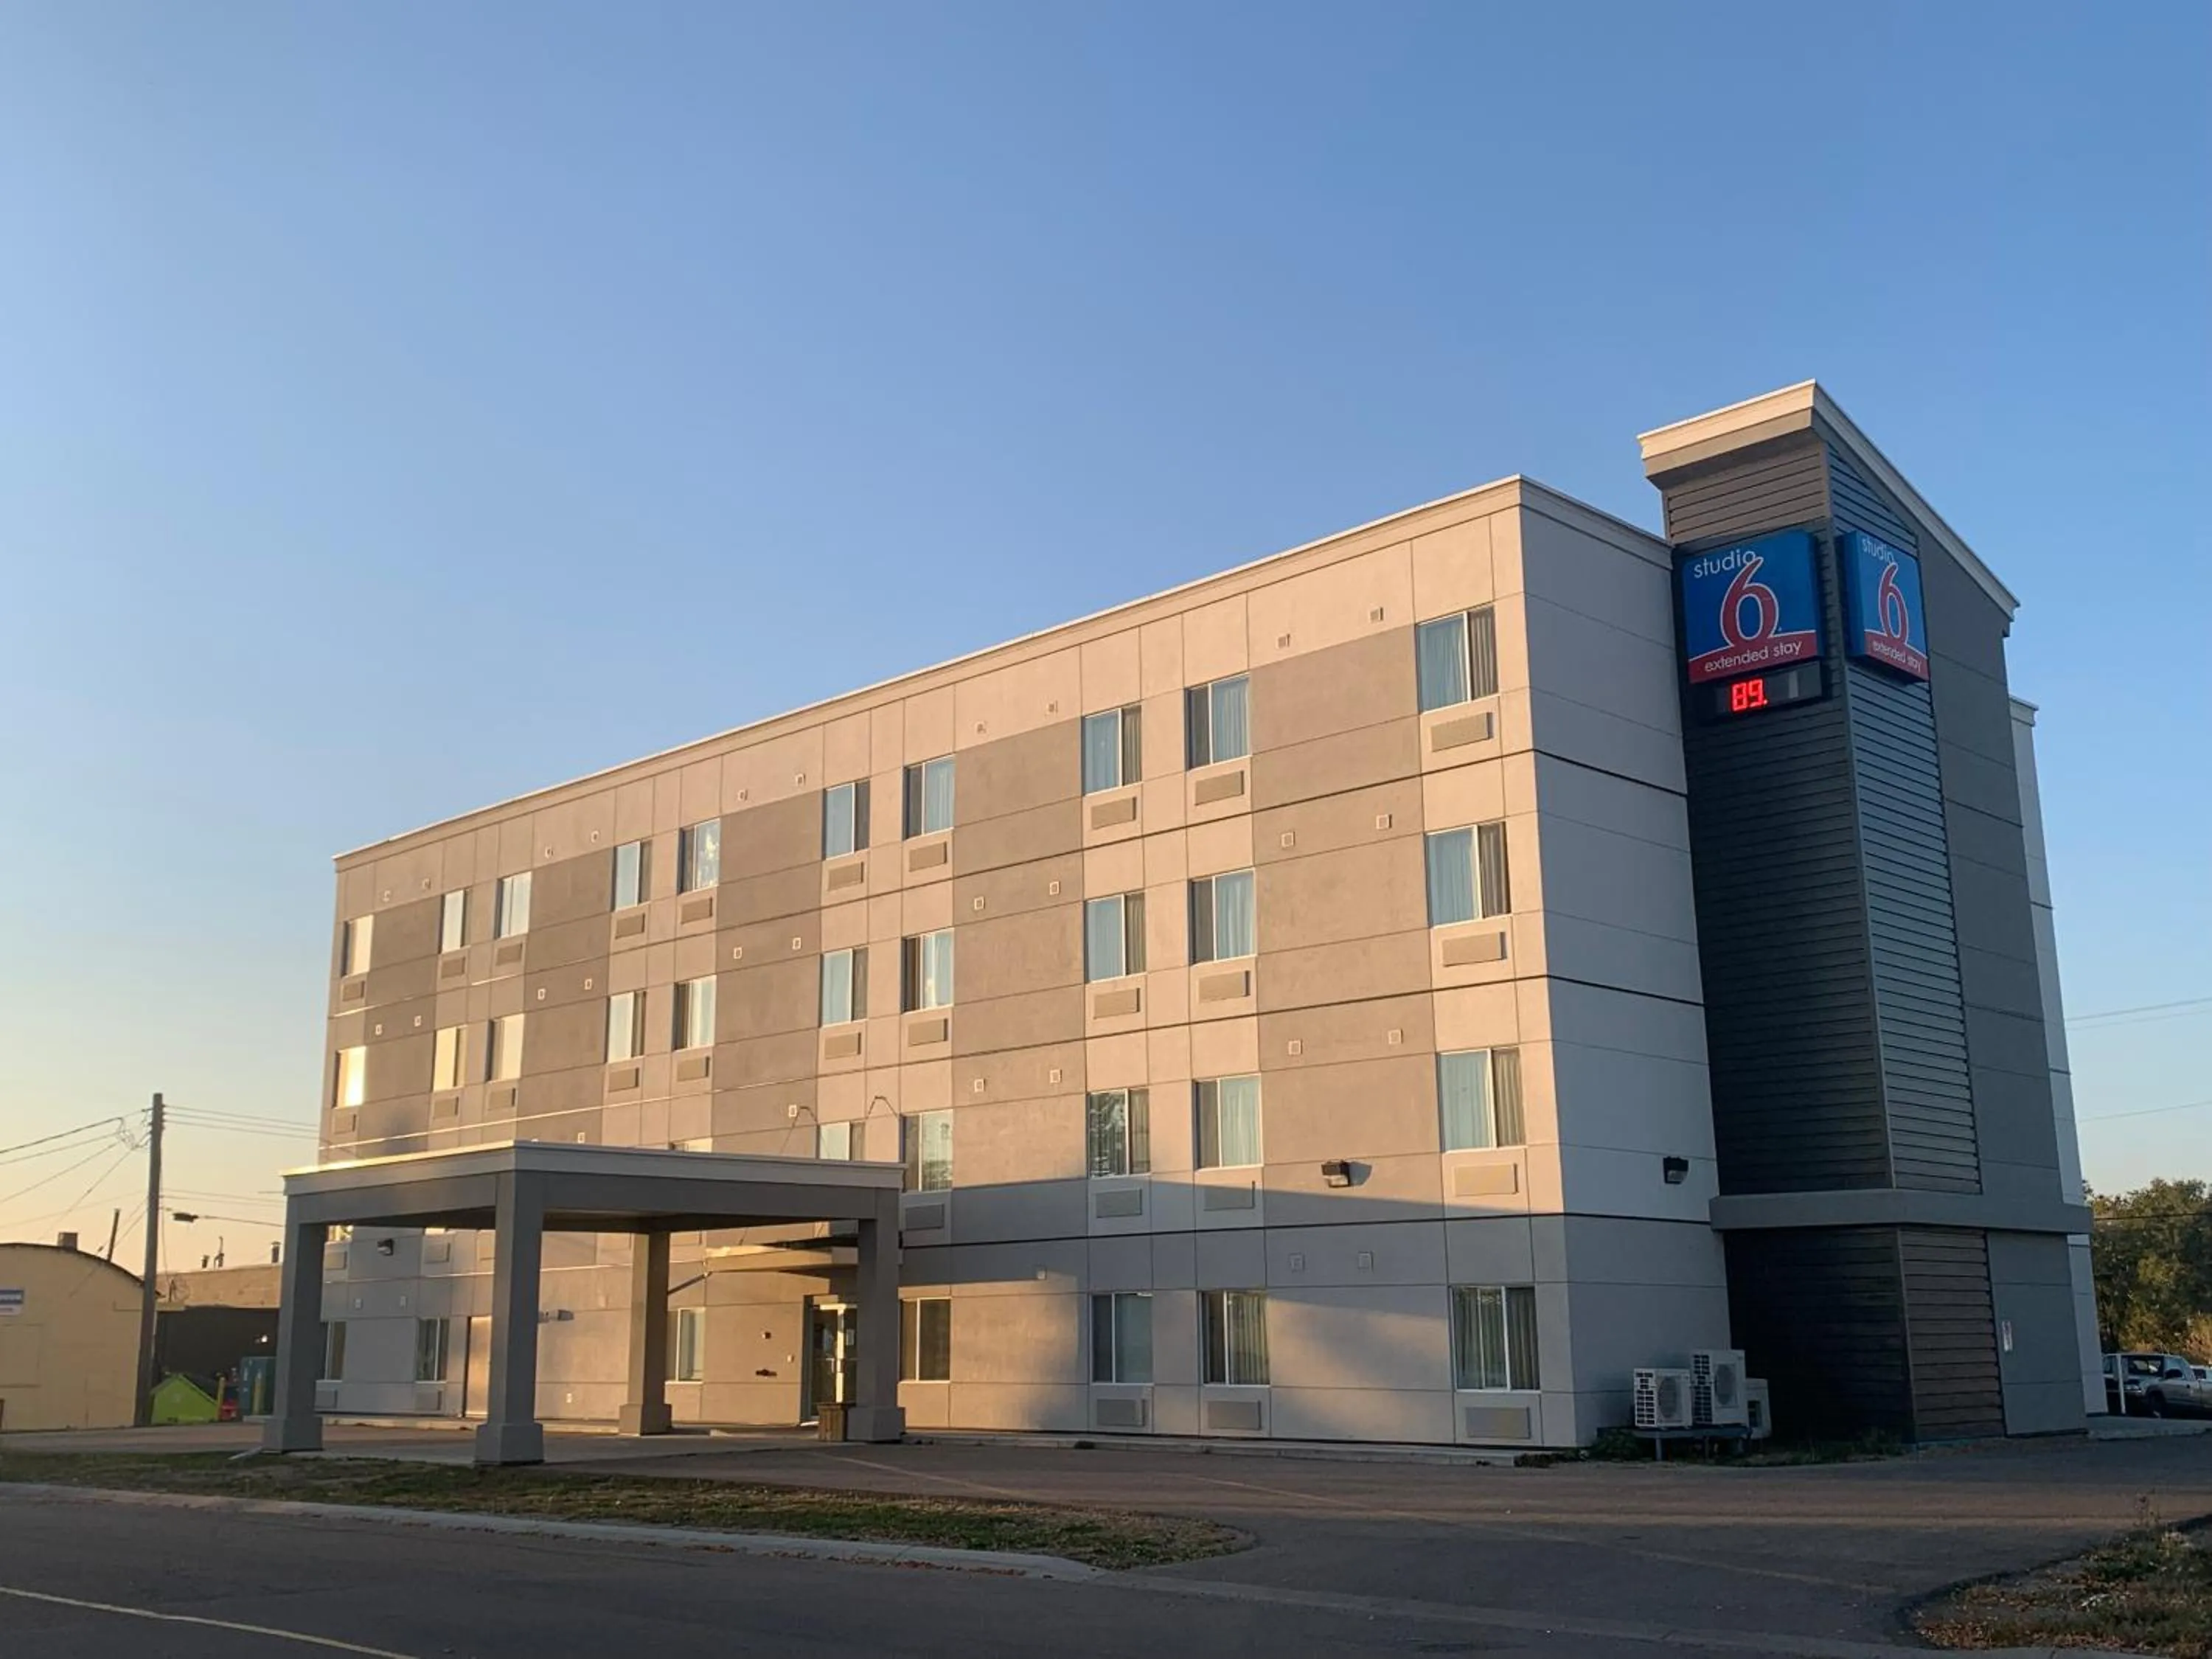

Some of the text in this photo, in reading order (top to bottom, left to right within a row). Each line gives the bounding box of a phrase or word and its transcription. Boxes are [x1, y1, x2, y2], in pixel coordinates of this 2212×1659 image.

[1694, 548, 1756, 579] studio
[1862, 537, 1894, 563] studio
[1720, 556, 1779, 646] 6
[1878, 561, 1909, 644] 6
[1704, 640, 1802, 672] extended stay
